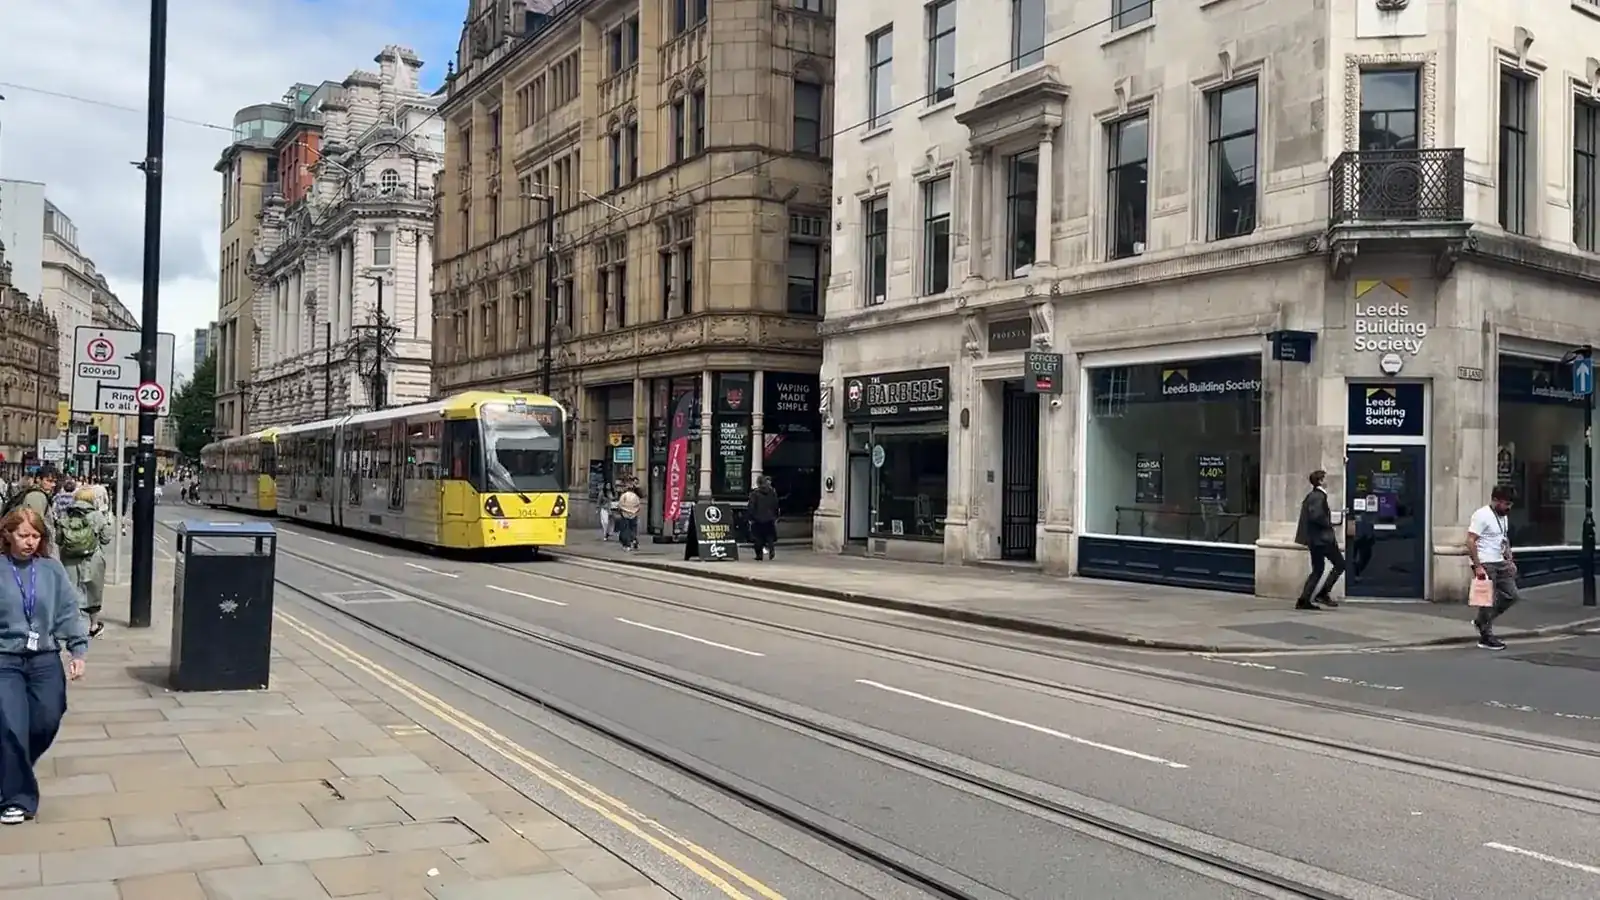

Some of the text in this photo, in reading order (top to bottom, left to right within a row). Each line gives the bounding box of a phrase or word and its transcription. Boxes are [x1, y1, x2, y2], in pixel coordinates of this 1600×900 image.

[1355, 303, 1409, 317] Leeds
[1355, 320, 1426, 337] Building
[1354, 337, 1423, 354] Society
[1030, 354, 1058, 362] OFFICES
[82, 367, 100, 375] 200
[1030, 362, 1057, 371] TO LET
[777, 383, 810, 393] VAPING
[1163, 379, 1261, 394] Leeds Building Society
[112, 392, 135, 402] Ring
[141, 389, 160, 401] 20
[867, 379, 943, 405] BARBERS
[780, 393, 806, 402] MADE
[1366, 398, 1396, 406] Leeds
[105, 401, 115, 410] to
[118, 402, 131, 410] all
[777, 402, 809, 411] SIMPLE
[1366, 407, 1406, 417] Building
[1366, 416, 1404, 427] Society
[669, 443, 680, 517] VAPES
